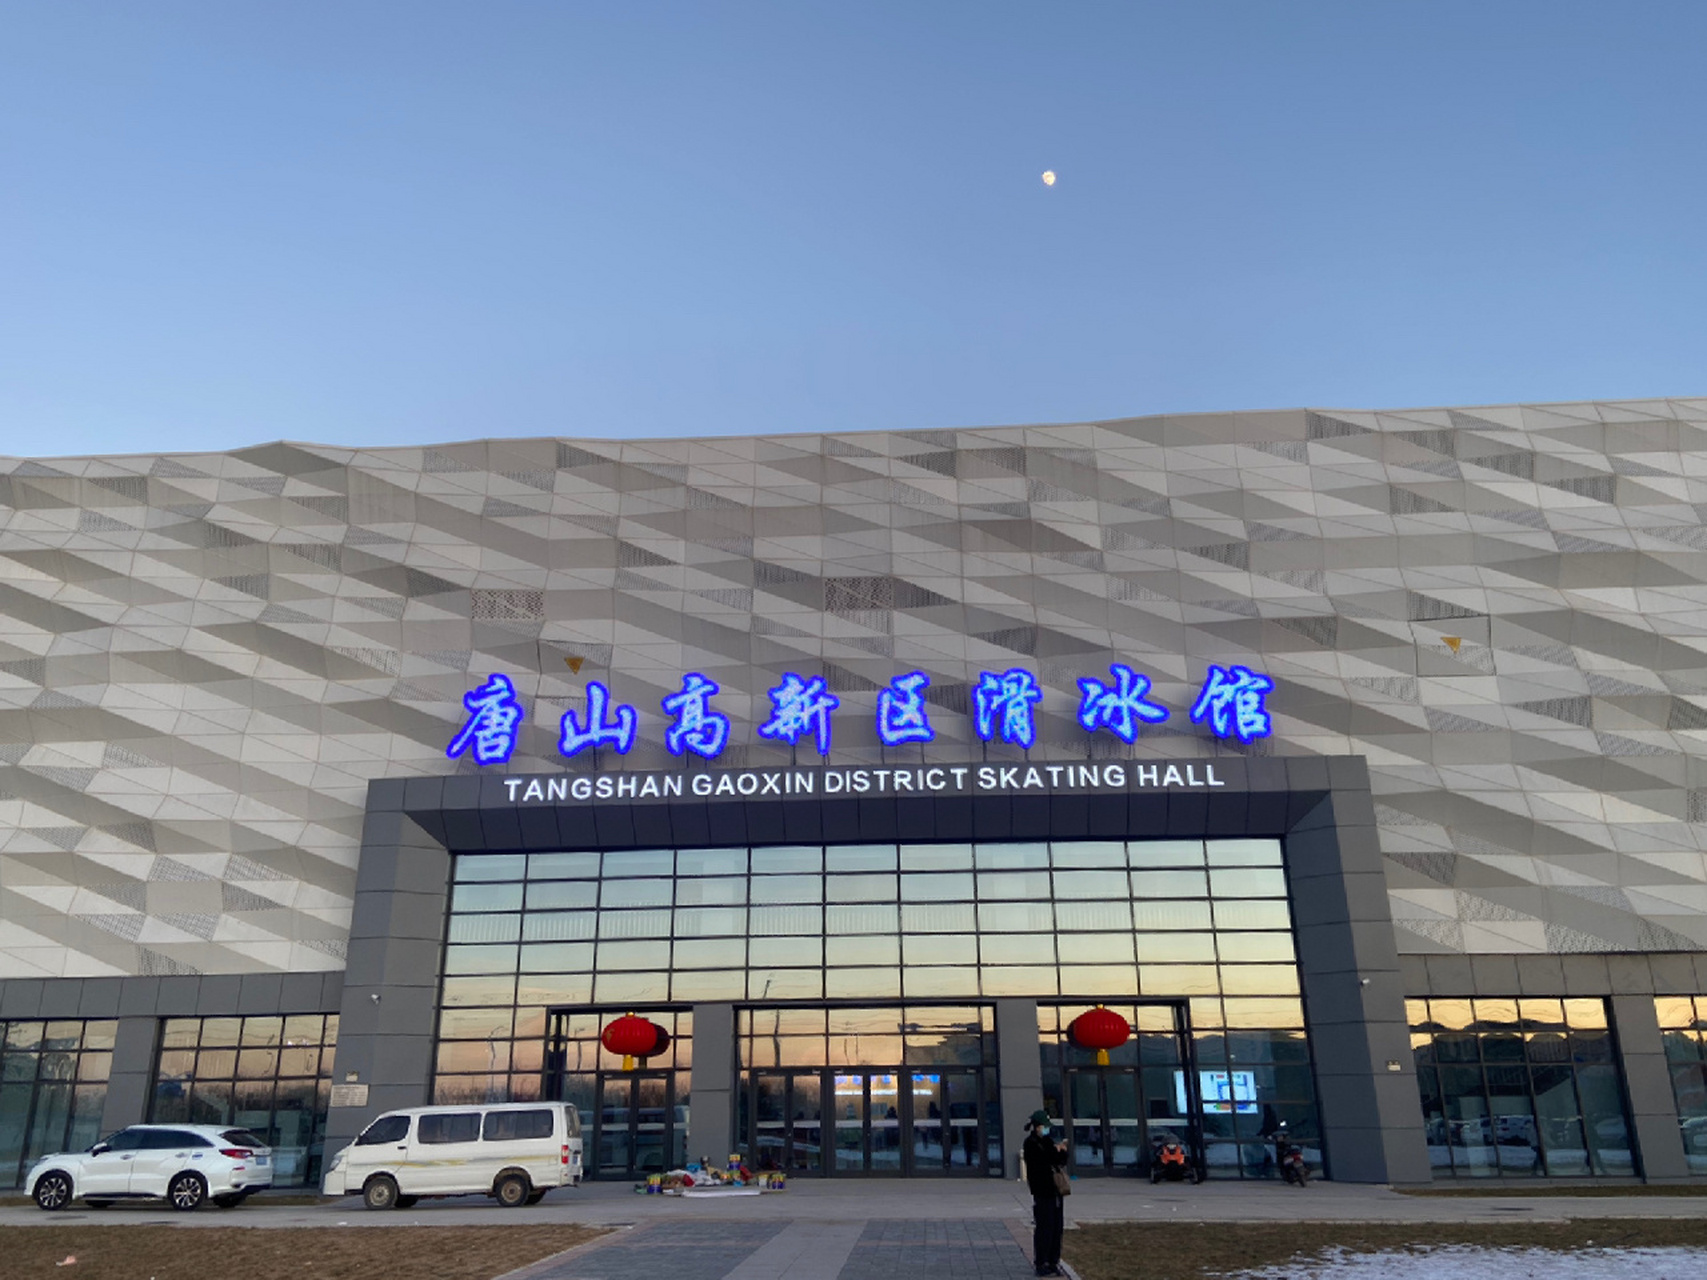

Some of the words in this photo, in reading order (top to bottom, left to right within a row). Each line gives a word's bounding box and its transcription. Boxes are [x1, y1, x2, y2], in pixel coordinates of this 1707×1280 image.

[447, 663, 1275, 766] 唐山高新区滑冰馆
[503, 774, 683, 802] TANGSHAN
[690, 771, 814, 797] GAOXIN
[823, 768, 969, 793] DISTRICT
[977, 764, 1126, 790] SKATING
[1136, 763, 1225, 787] HALL
